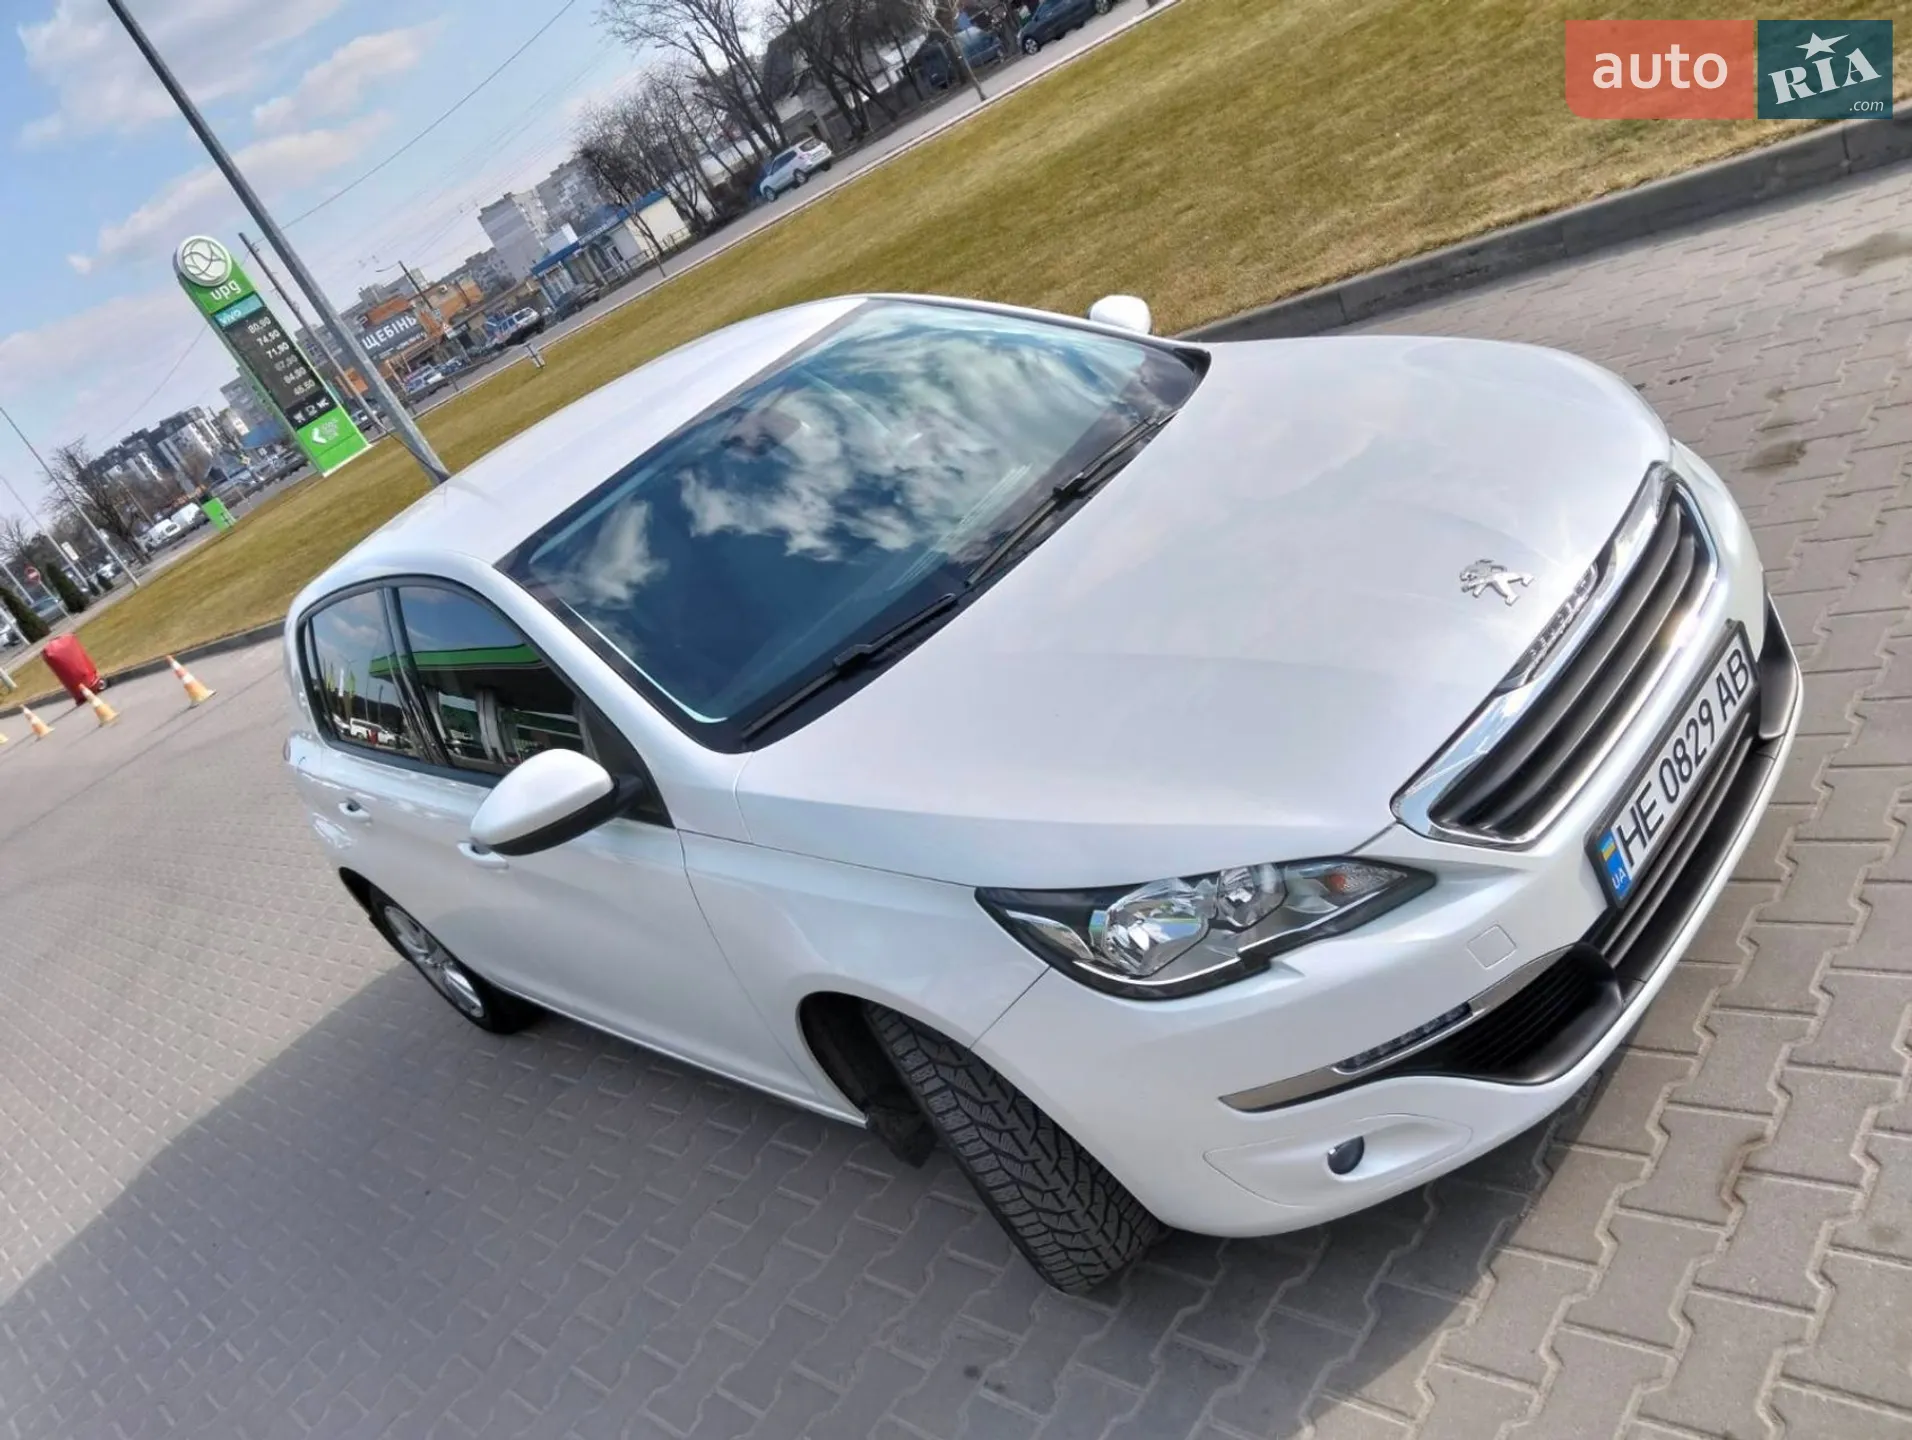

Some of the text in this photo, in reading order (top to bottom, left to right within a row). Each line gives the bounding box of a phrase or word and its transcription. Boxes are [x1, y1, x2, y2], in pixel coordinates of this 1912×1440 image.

[210, 280, 242, 301] upg
[361, 315, 417, 350] ЩЕБІНЬ
[1617, 648, 1749, 867] HE 0829 AB
[1612, 868, 1629, 890] UA
